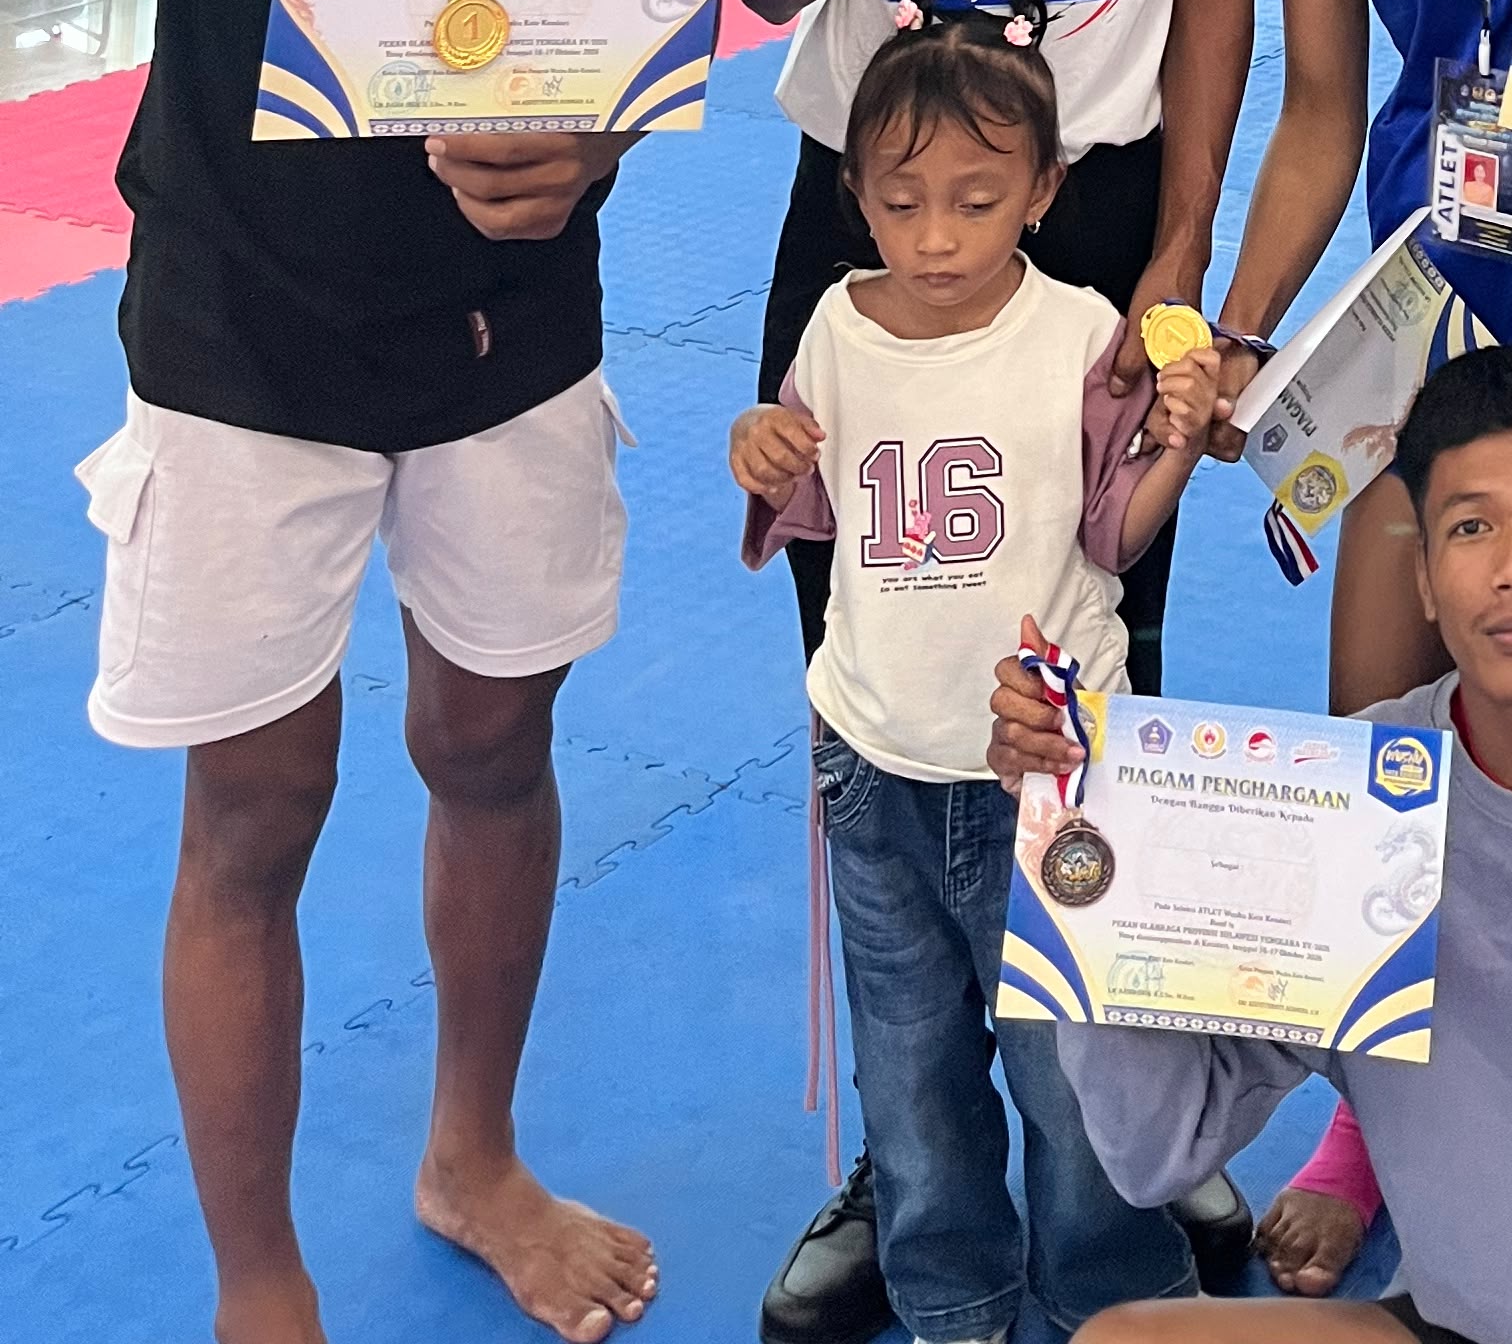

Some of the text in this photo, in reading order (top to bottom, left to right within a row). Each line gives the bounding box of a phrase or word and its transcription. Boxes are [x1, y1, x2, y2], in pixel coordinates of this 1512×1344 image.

[463, 11, 481, 41] 1
[1438, 141, 1458, 224] ATLET
[859, 436, 1005, 568] 16
[1117, 765, 1350, 811] PIAGAM PENGHARGAAN
[1151, 795, 1314, 823] Dengan Bangga Diberikan Kepada
